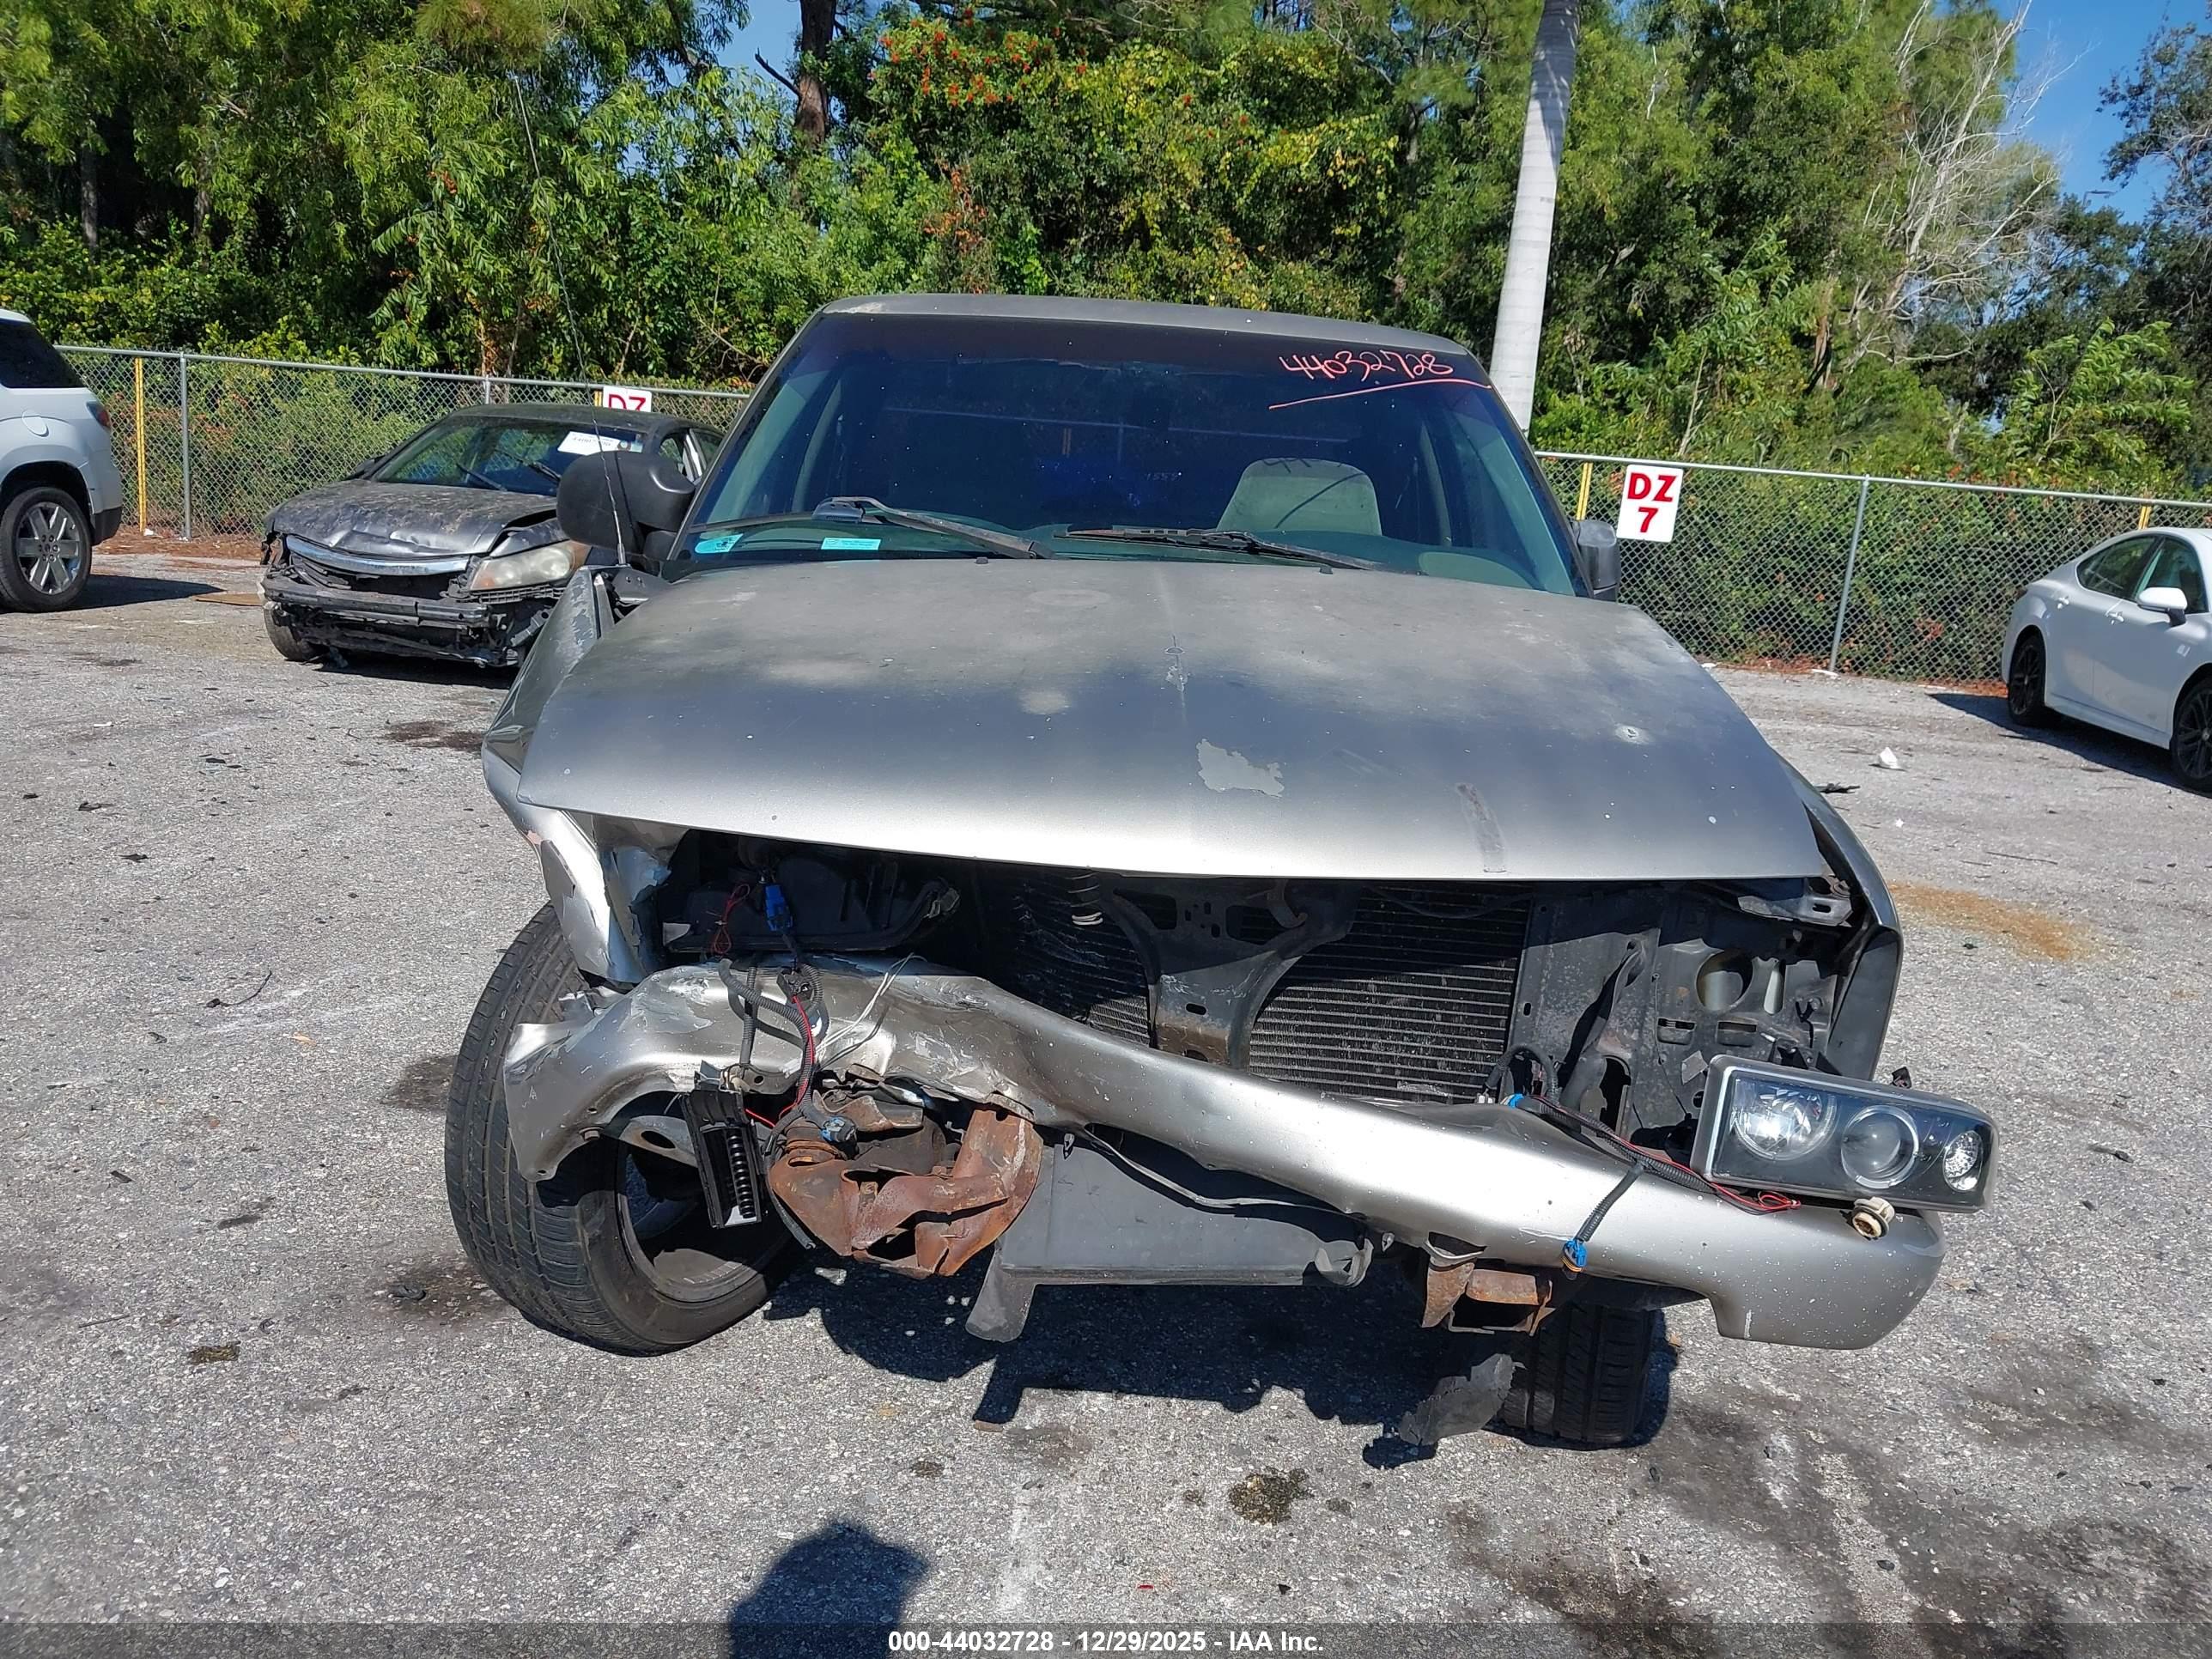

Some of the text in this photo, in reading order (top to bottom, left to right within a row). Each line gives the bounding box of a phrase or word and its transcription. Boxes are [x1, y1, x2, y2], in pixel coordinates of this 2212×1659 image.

[1279, 349, 1454, 381] 44032728
[1627, 472, 1677, 502] DZ
[1638, 507, 1659, 533] 7
